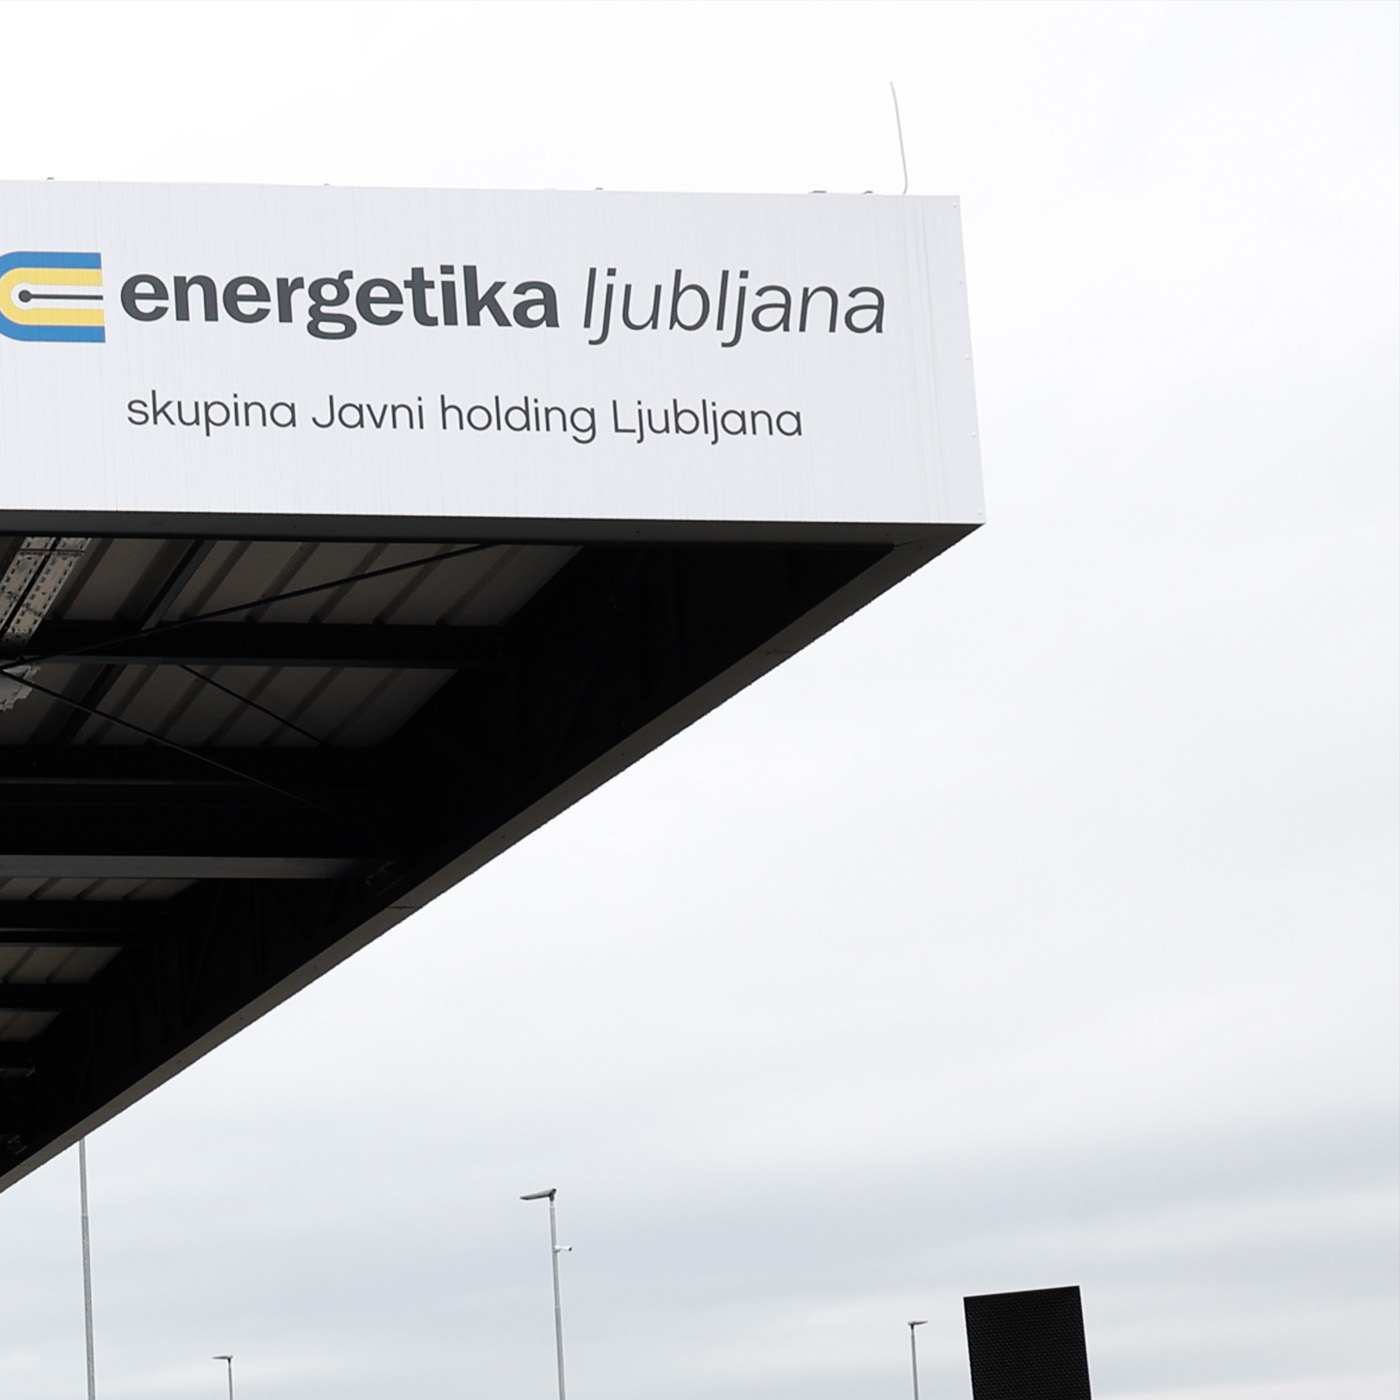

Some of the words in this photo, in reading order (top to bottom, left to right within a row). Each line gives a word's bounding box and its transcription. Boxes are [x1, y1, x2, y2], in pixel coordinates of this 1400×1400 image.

[120, 264, 560, 340] energetika
[583, 267, 885, 348] ljubljana
[127, 389, 297, 437] skupina
[311, 394, 424, 430] Javni
[440, 394, 597, 445] holding
[612, 398, 802, 446] Ljubljana
